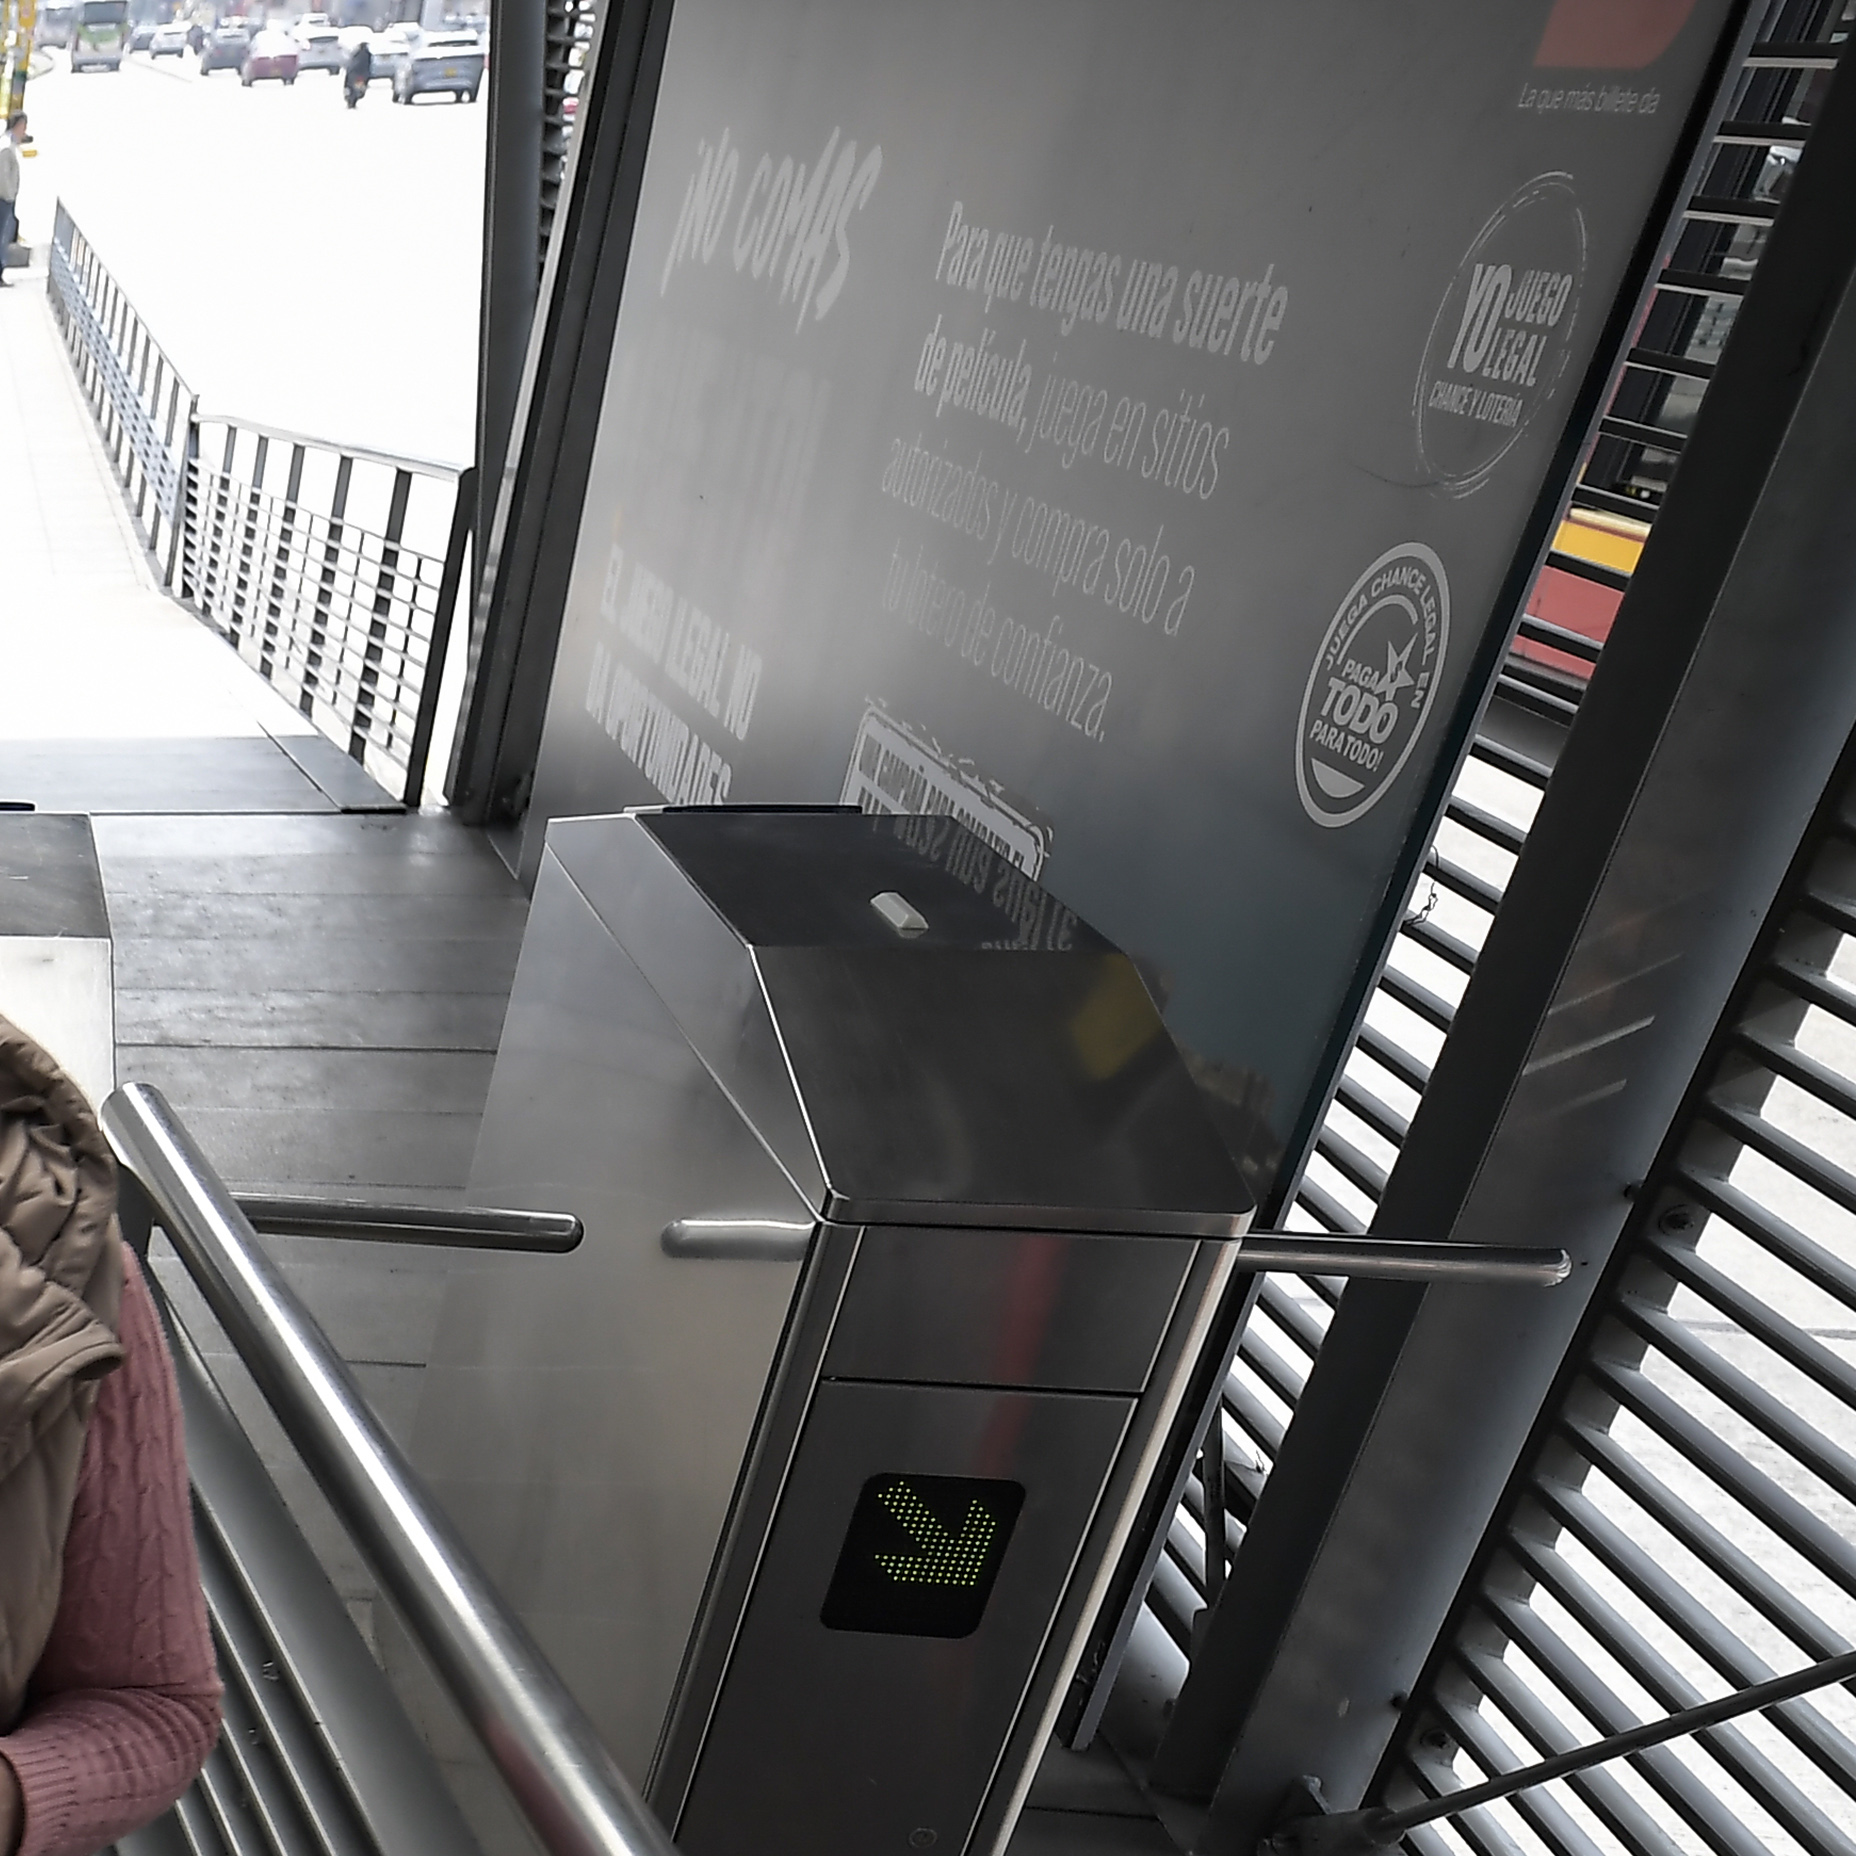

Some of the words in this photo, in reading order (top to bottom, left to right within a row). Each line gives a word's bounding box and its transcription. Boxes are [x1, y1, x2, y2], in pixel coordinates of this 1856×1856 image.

[1537, 89, 1564, 115] que
[935, 201, 988, 291] Para
[985, 231, 1034, 313] que
[1030, 224, 1122, 337] tengas
[1117, 259, 1179, 338] una
[1173, 263, 1288, 365] suerte
[1447, 263, 1513, 373] YO
[1504, 268, 1573, 328] JUEGO
[1482, 327, 1548, 387] LEGAL
[914, 313, 947, 396] de
[1025, 351, 1108, 470] juega
[1103, 396, 1147, 470] en
[1141, 388, 1230, 500] sitios
[1428, 380, 1473, 415] CHANCE
[1468, 388, 1484, 417] Y
[988, 487, 1018, 566] y
[1011, 496, 1110, 597] compra
[1104, 524, 1170, 624] solo
[1164, 565, 1195, 637] a
[1371, 565, 1427, 599] CHANCE
[1325, 592, 1368, 671] JUEGA
[1420, 585, 1438, 666] LEGAL
[724, 644, 763, 741] NO
[991, 614, 1113, 743] confianza.
[1321, 676, 1399, 745] TODO
[1342, 659, 1380, 690] PAGA
[1411, 671, 1430, 710] EN
[1309, 719, 1342, 756] PARA
[1342, 732, 1385, 773] TODO!
